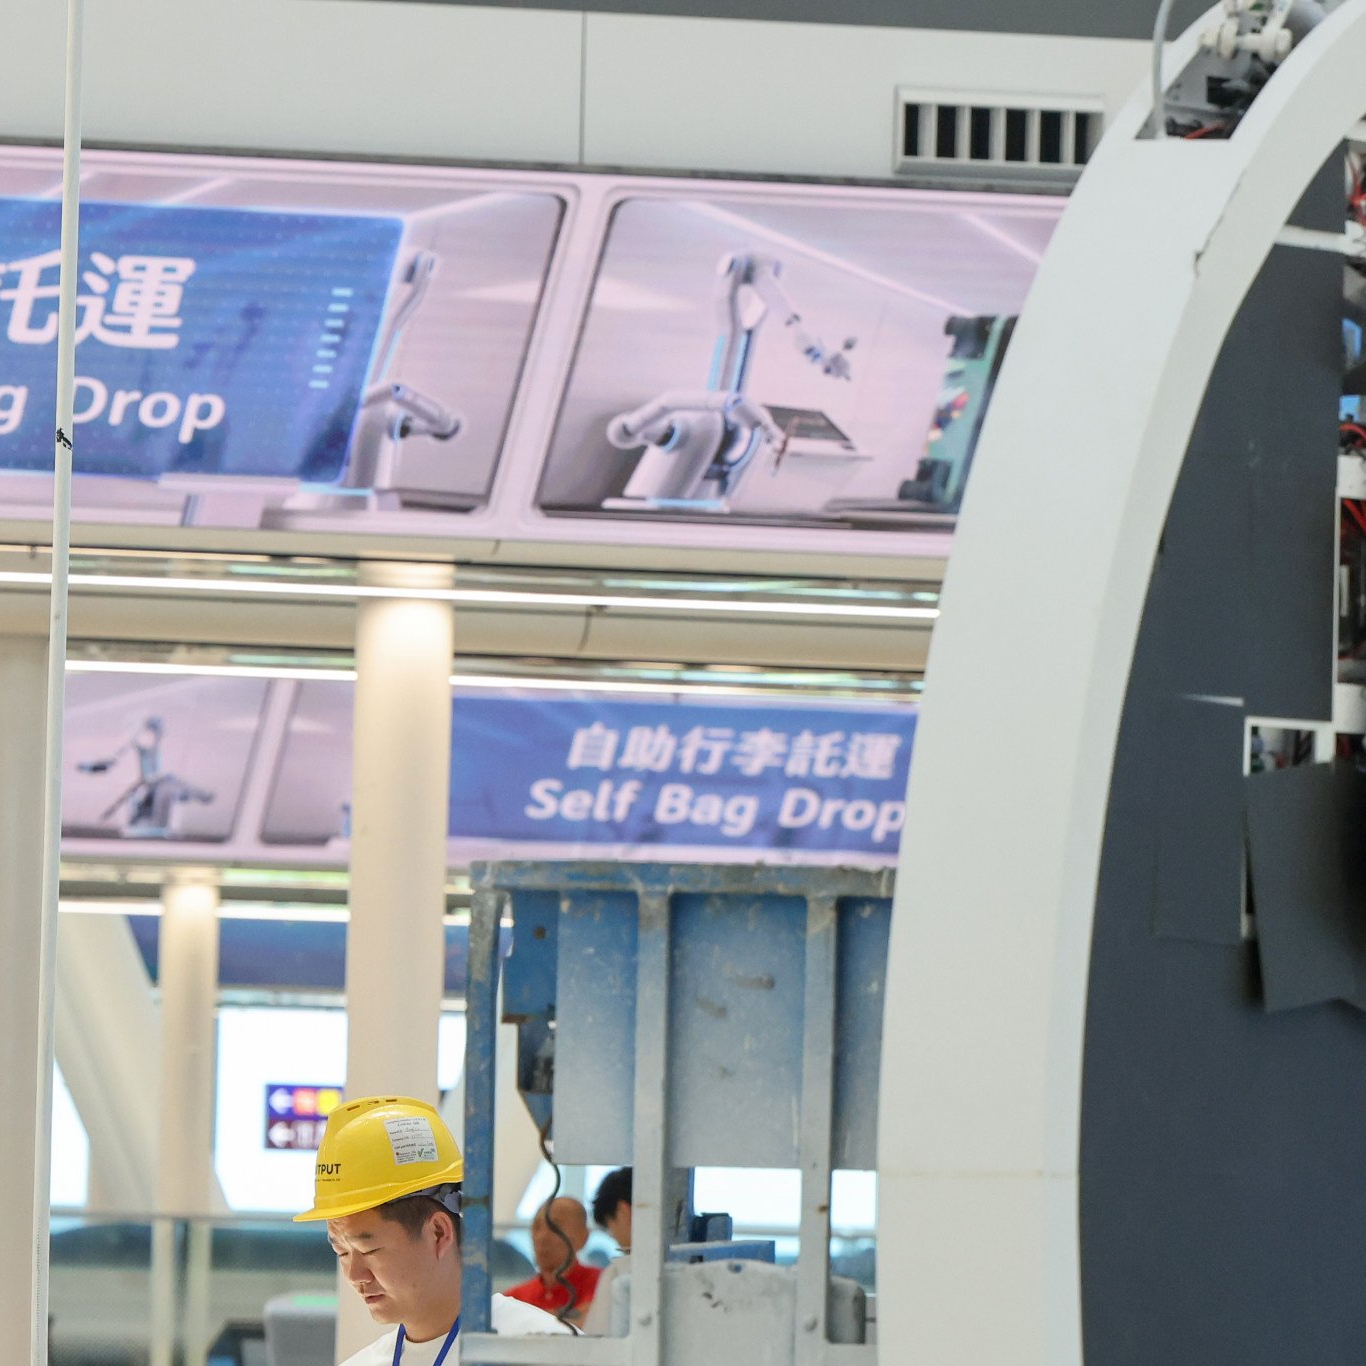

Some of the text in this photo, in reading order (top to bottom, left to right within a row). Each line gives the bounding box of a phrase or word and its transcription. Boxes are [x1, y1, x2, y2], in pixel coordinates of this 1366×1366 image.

[72, 376, 226, 444] Drop
[567, 722, 902, 779] 自助行李託運
[524, 778, 906, 843] Self Bag Drop
